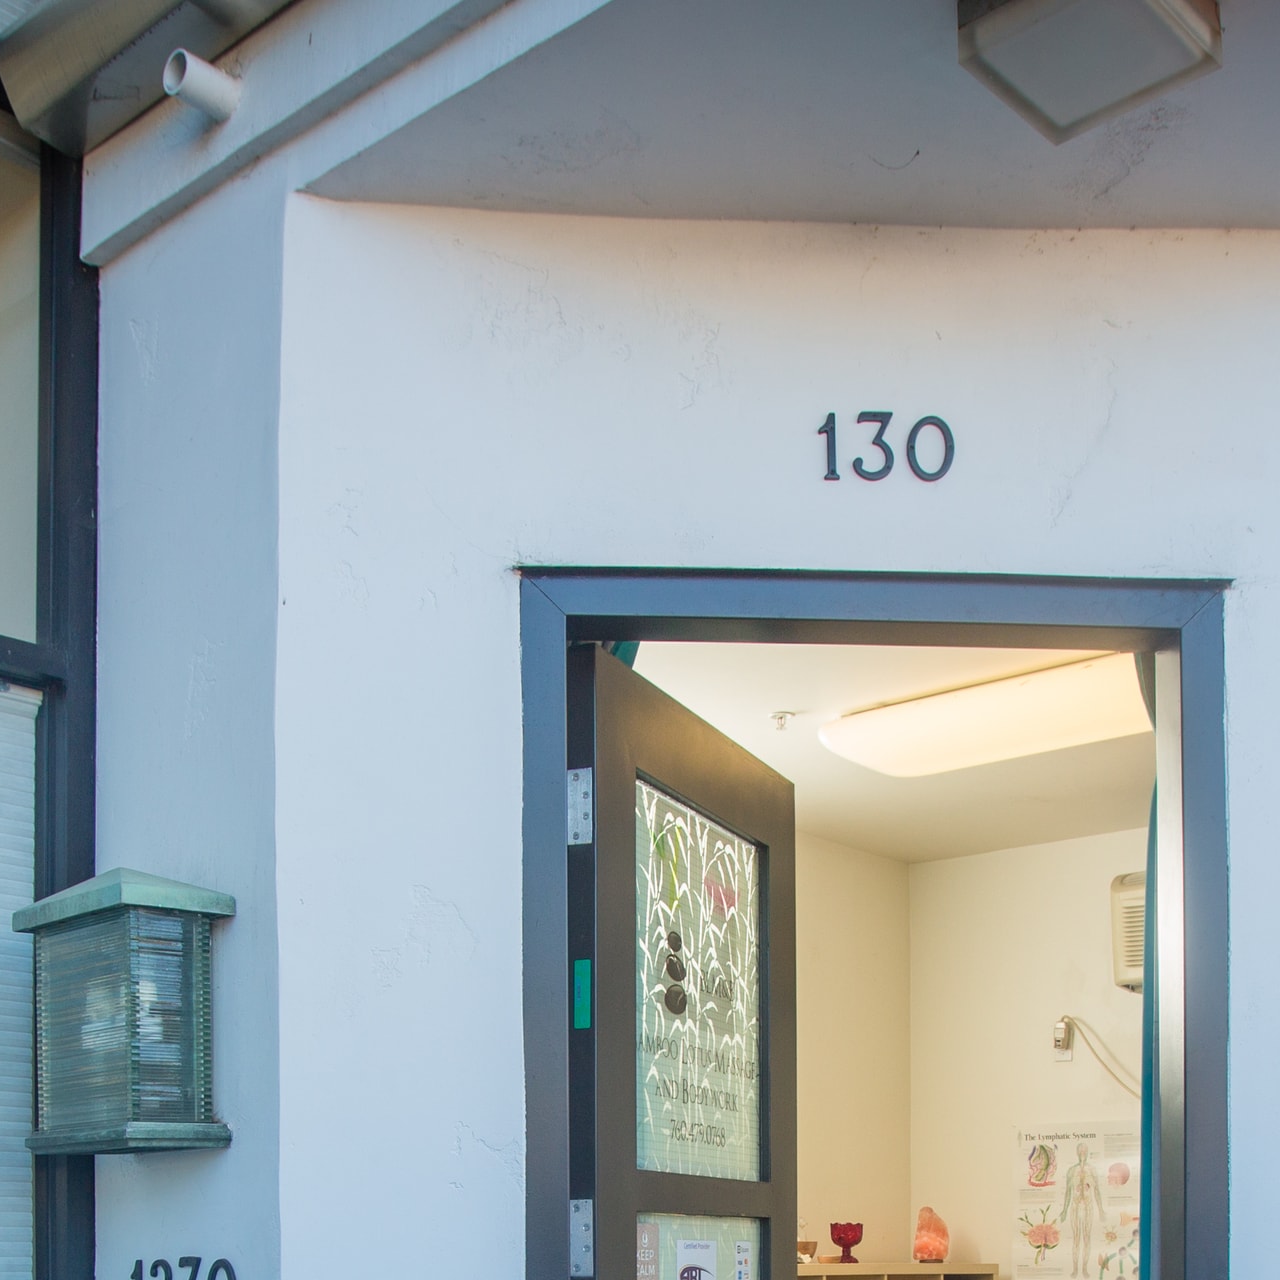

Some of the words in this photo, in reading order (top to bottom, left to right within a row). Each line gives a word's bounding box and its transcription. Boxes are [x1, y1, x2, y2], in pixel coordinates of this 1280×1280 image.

[817, 411, 955, 482] 130
[637, 1032, 678, 1060] AMBOO
[681, 1038, 712, 1067] LOTUS
[714, 1050, 756, 1081] MASSAGE
[655, 1079, 679, 1100] AND
[682, 1078, 739, 1112] BODYWORK
[670, 1119, 726, 1148] 760.479.0768
[1025, 1133, 1036, 1141] The
[1038, 1132, 1071, 1142] Lymphatic
[1072, 1132, 1096, 1141] System
